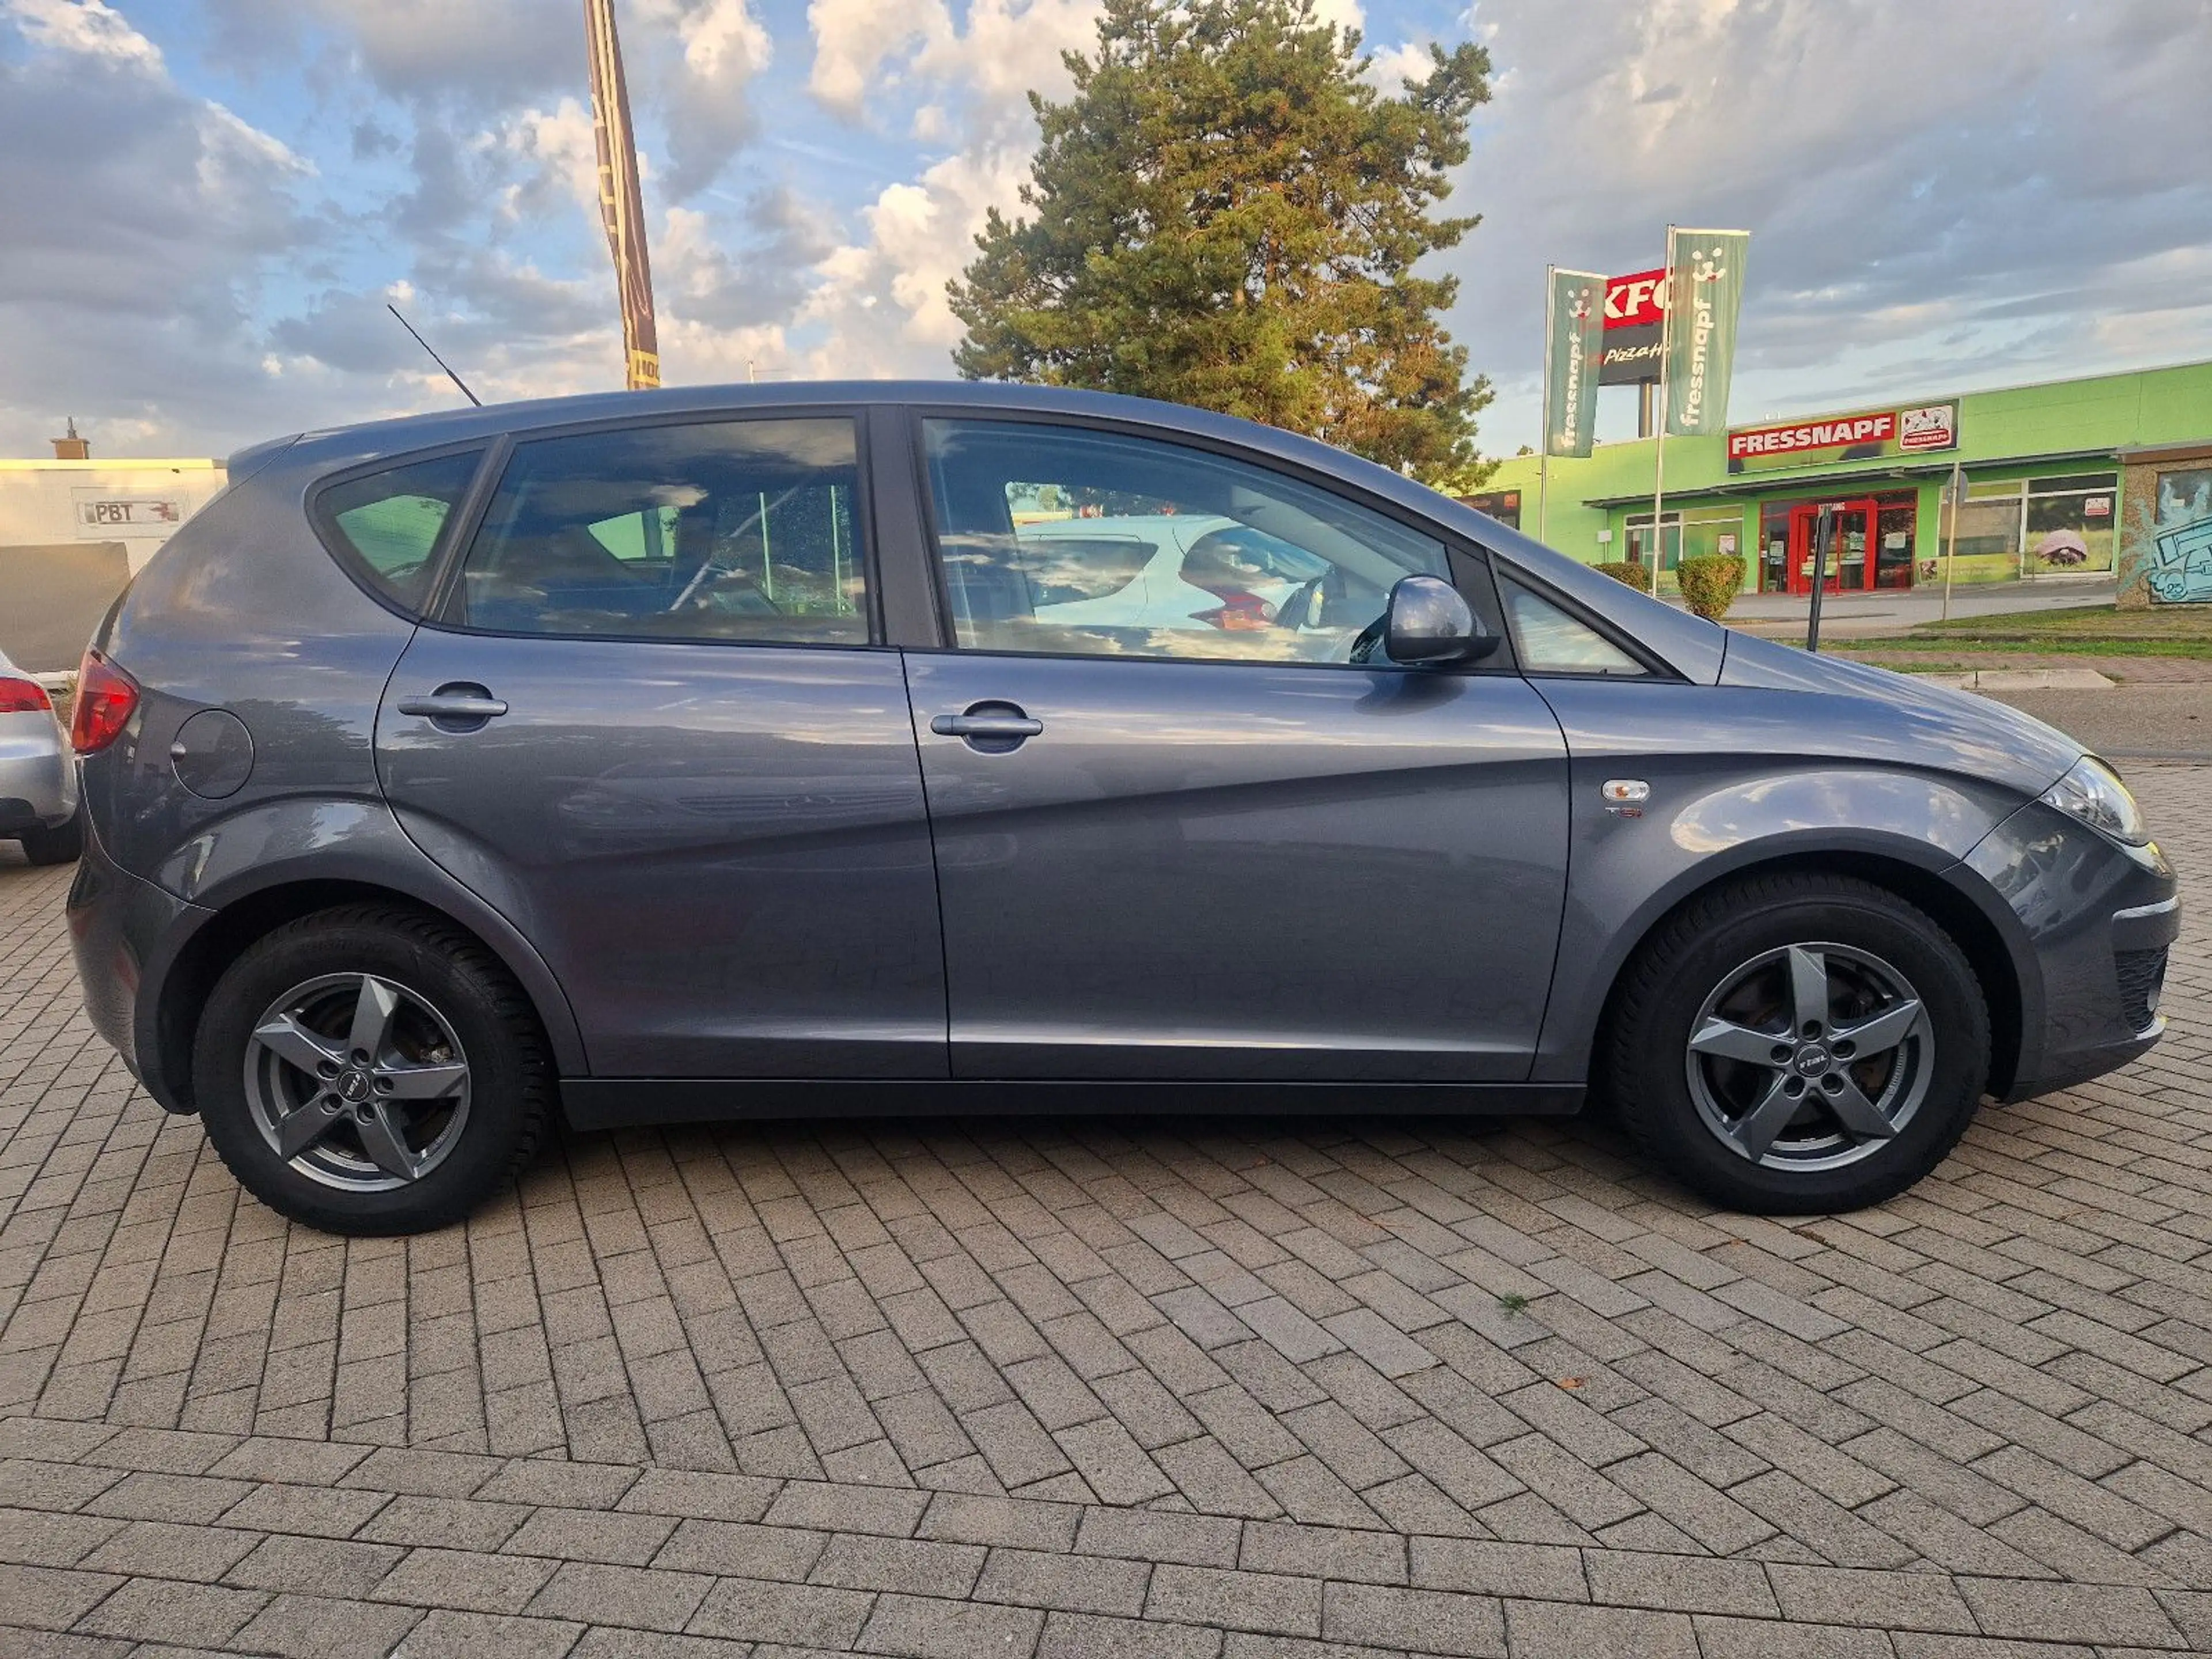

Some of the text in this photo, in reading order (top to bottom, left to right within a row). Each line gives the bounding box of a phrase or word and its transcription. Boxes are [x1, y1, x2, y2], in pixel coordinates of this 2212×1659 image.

[1560, 331, 1584, 448] fressnapf
[1679, 297, 1714, 426] fressnapf
[1732, 417, 1891, 454] FRESSNAPF
[96, 503, 133, 522] PBT
